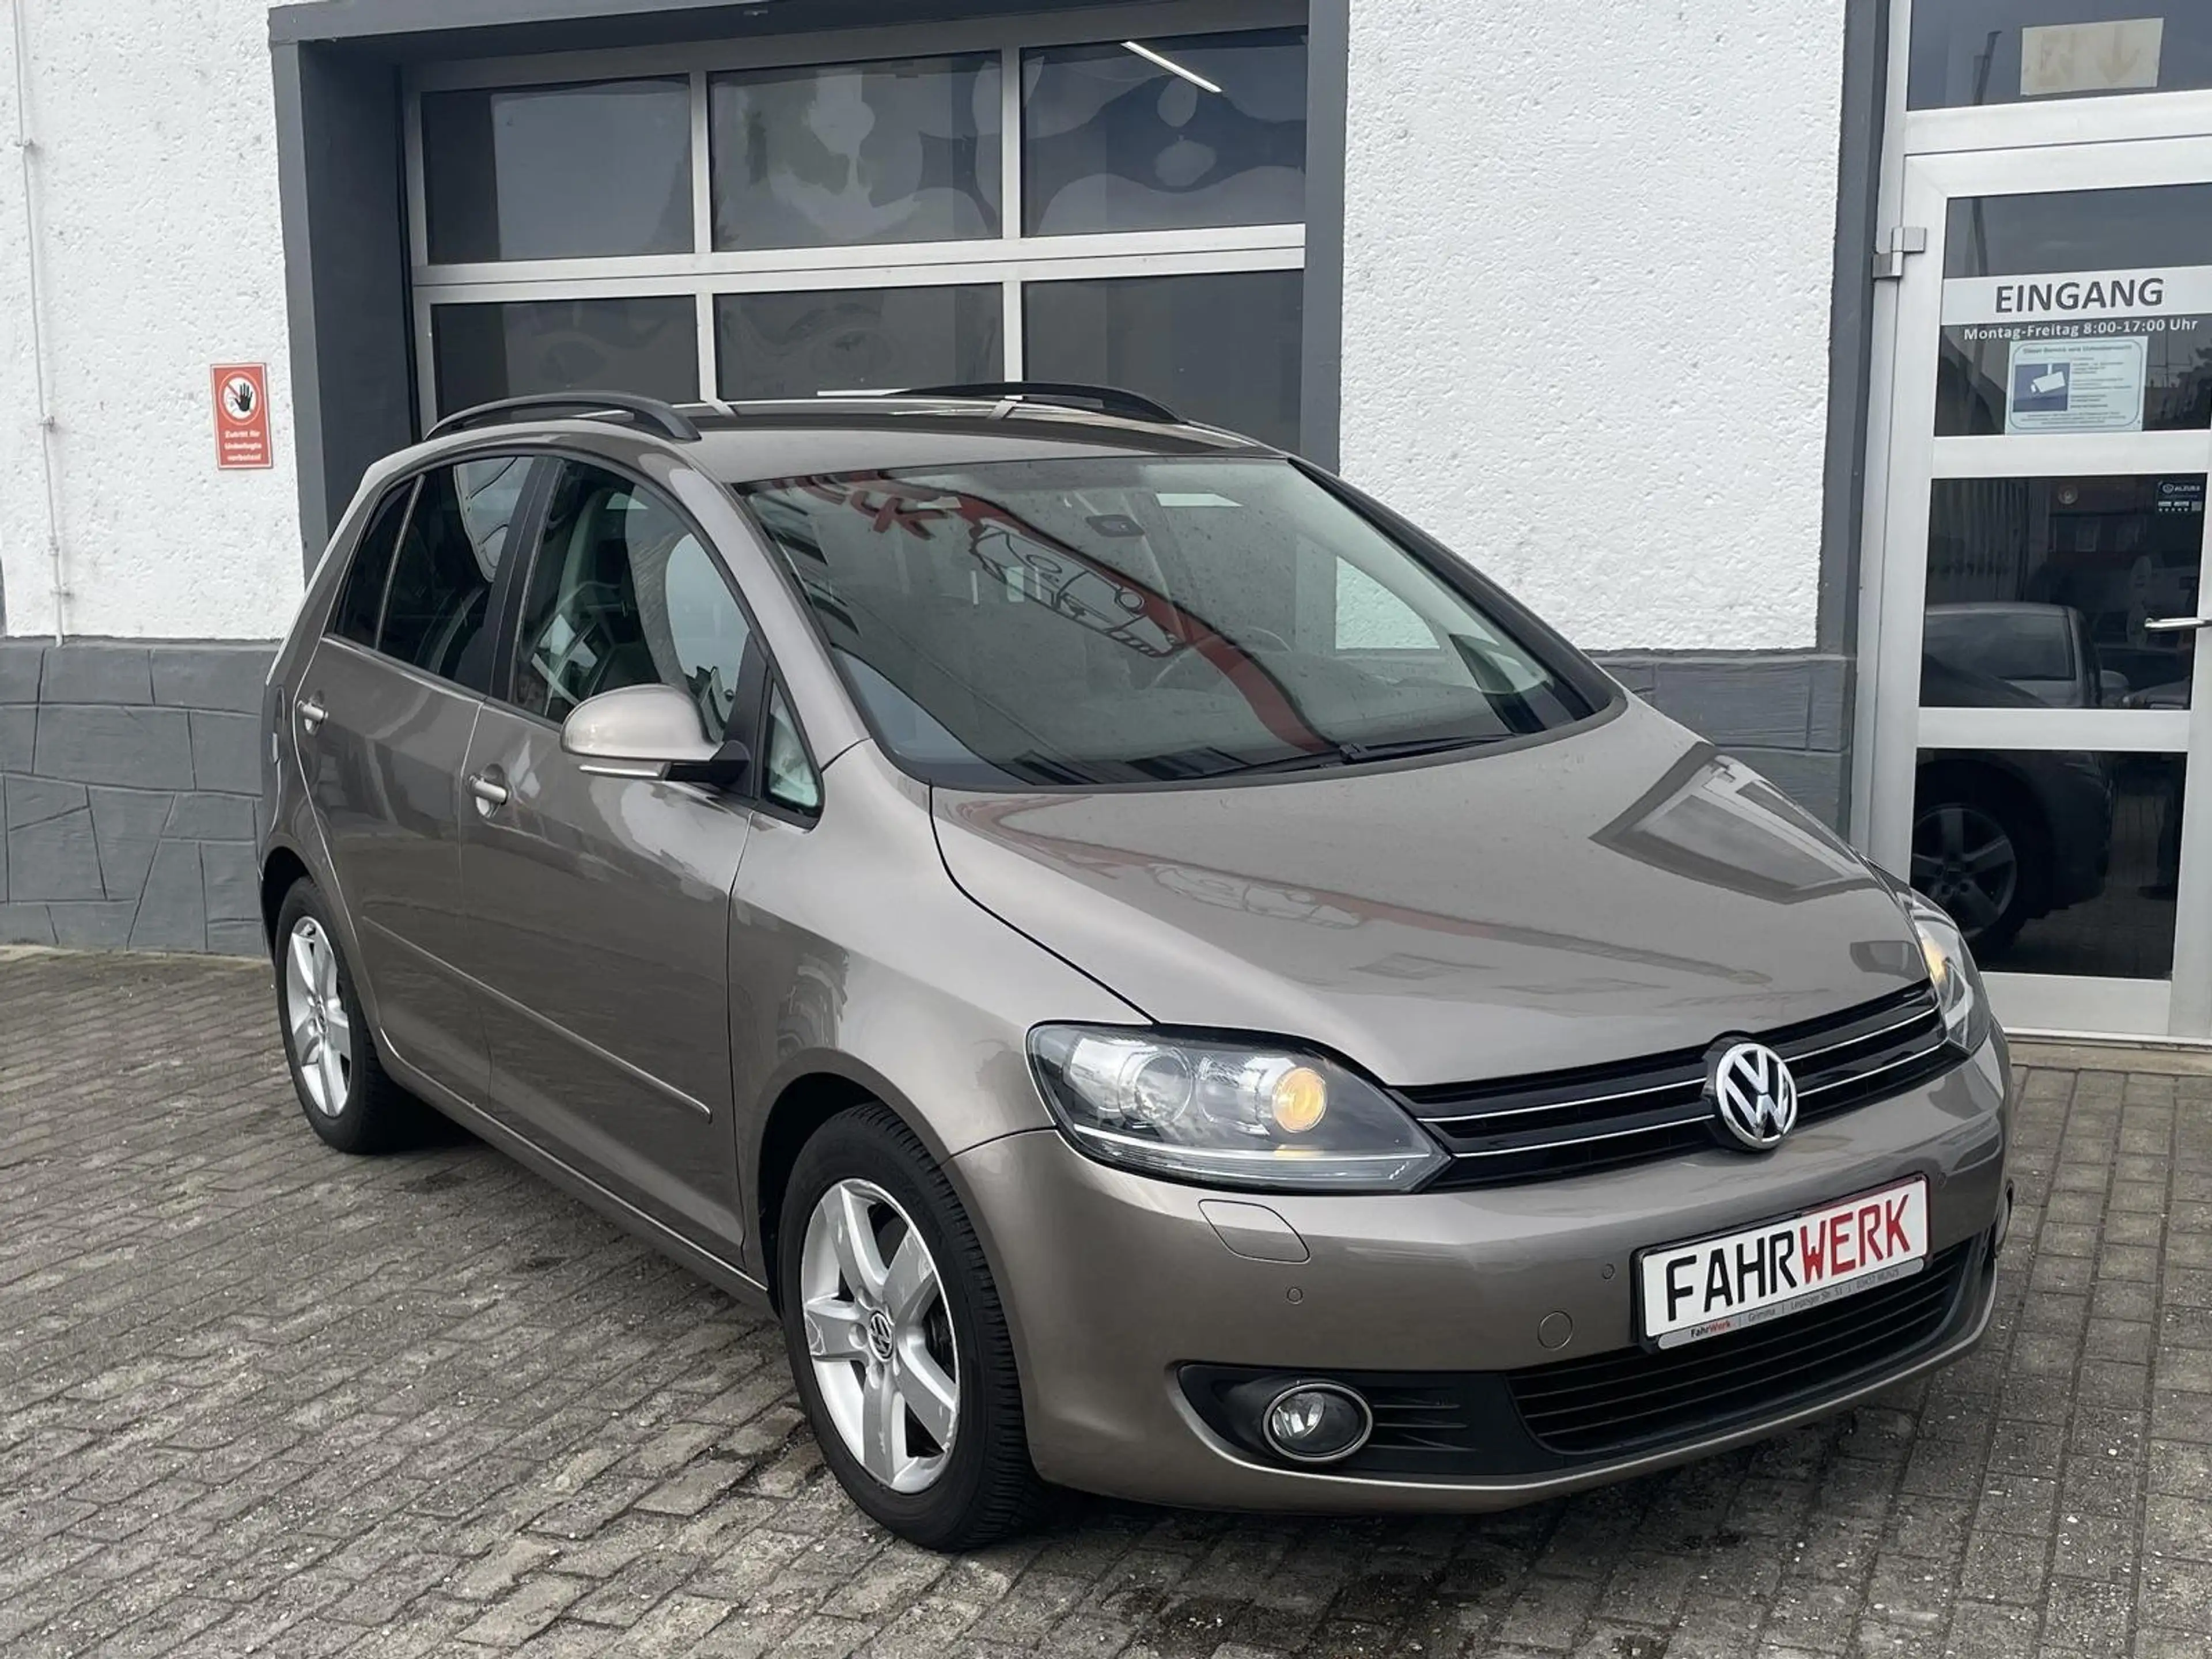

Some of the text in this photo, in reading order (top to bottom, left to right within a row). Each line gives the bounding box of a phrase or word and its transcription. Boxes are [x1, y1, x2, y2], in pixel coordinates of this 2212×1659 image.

[1995, 278, 2164, 313] EINGANG
[1964, 317, 2198, 341] Montag-Freitag 8:00-17:00 Uhr
[1665, 1194, 1911, 1322] FAHRWERK
[1690, 1320, 1731, 1338] FahrWerk
